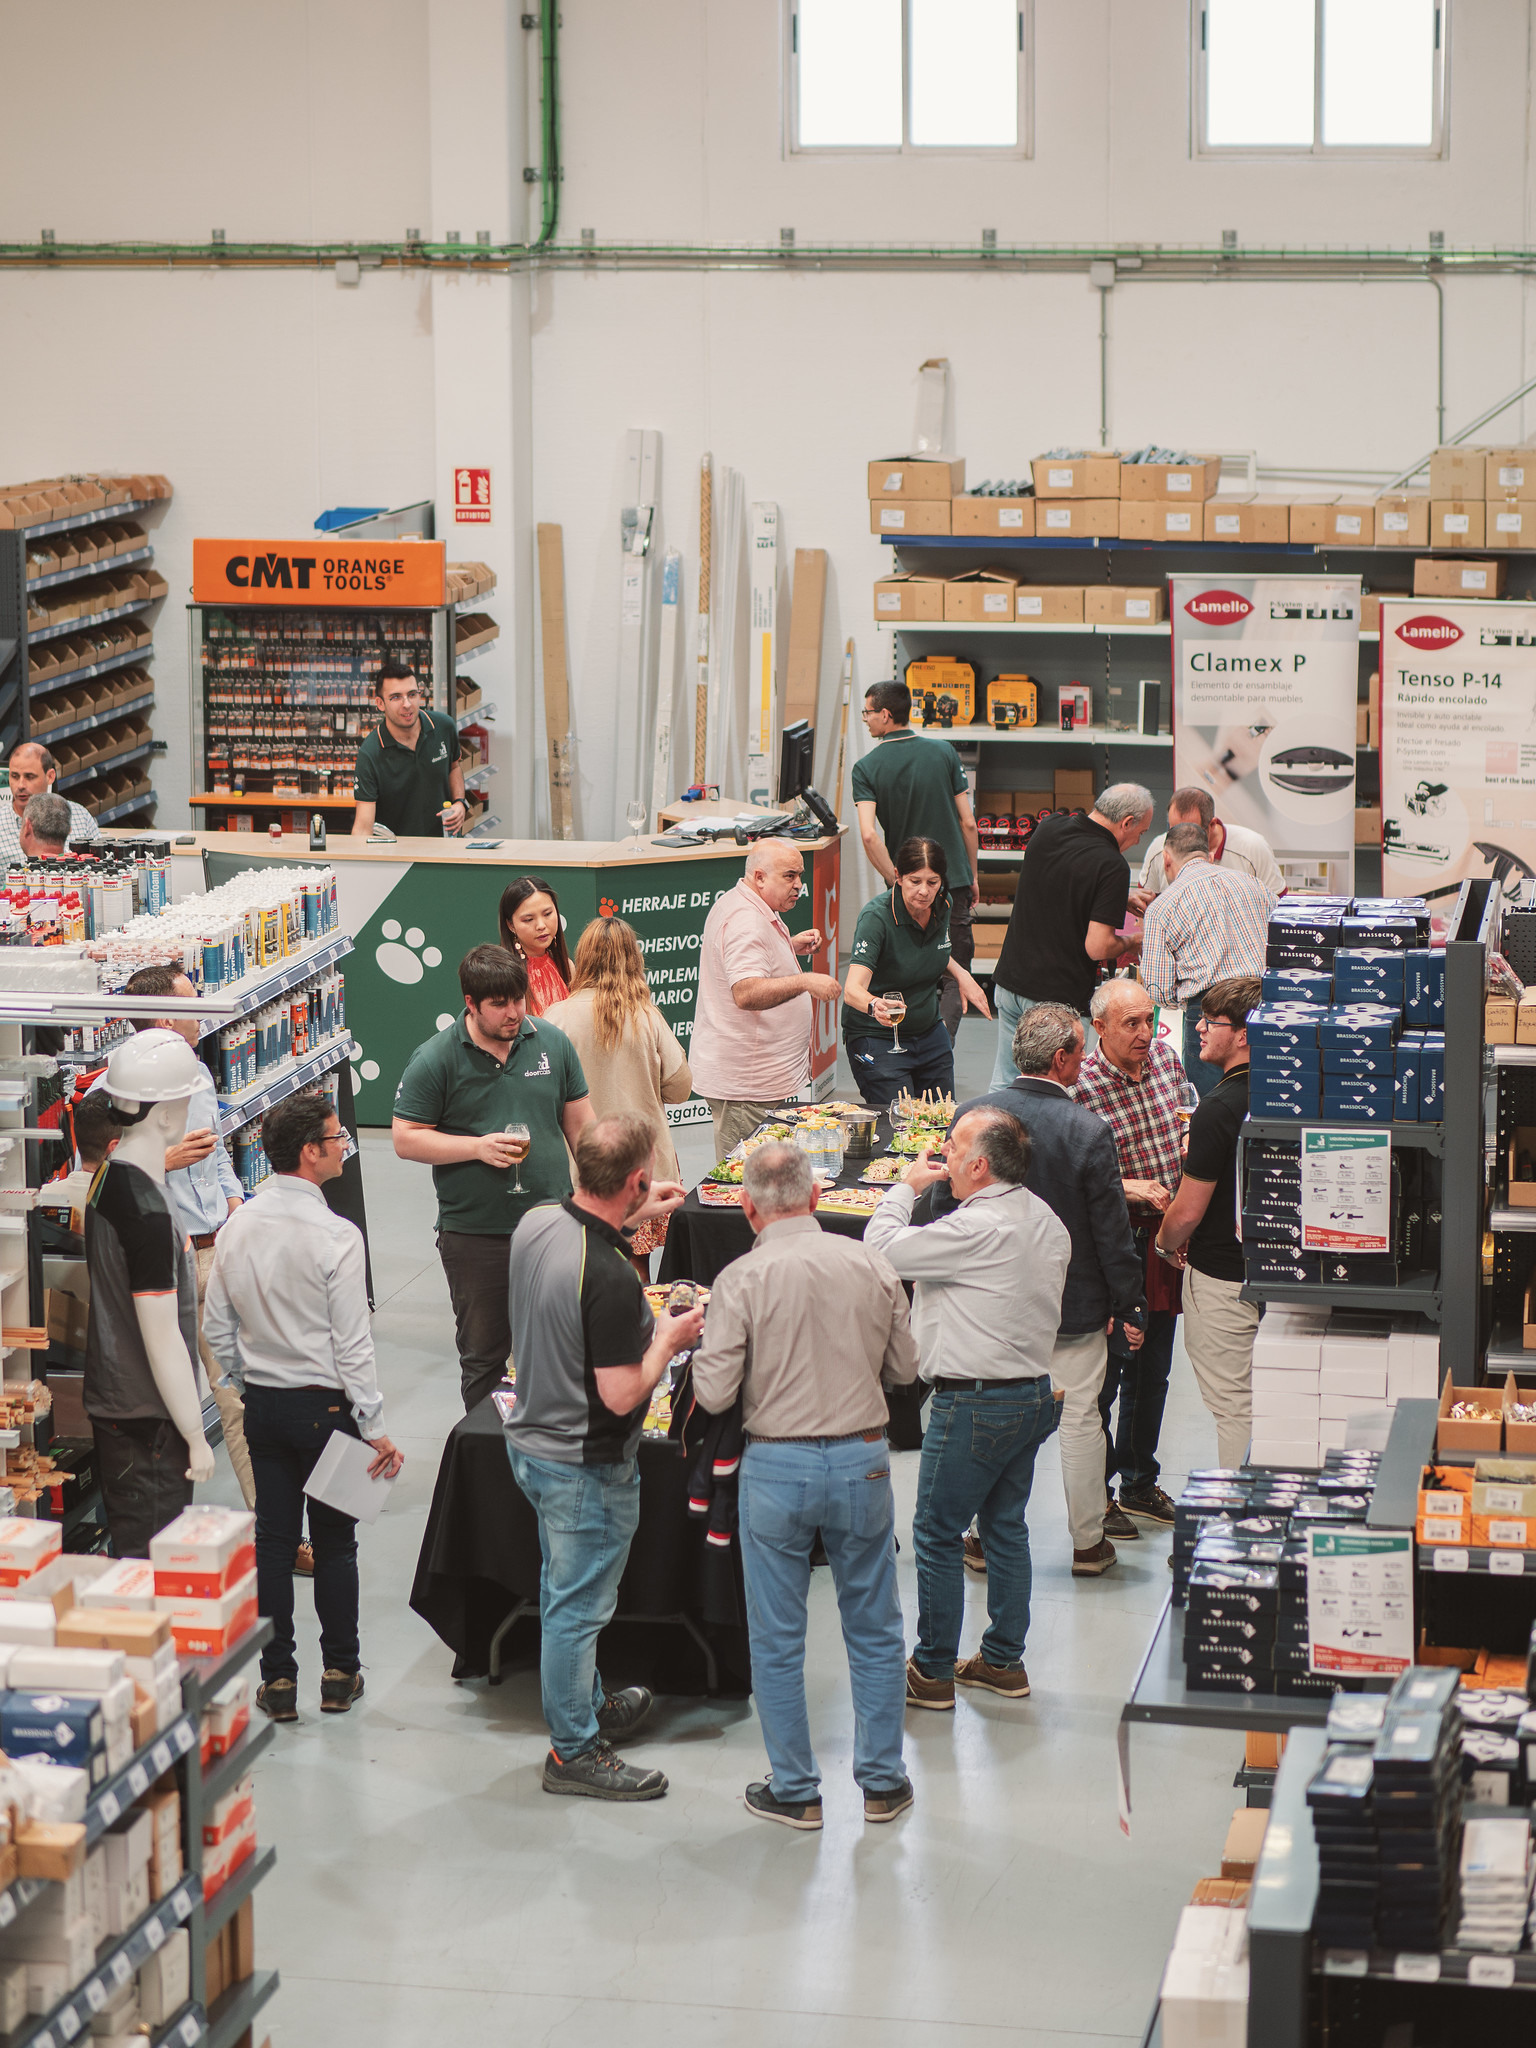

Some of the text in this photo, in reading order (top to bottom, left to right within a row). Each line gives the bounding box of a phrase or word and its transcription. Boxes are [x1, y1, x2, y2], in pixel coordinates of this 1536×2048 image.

[456, 512, 490, 520] EXTINTOR
[226, 553, 316, 589] CMT
[323, 559, 404, 574] ORANGE
[1192, 600, 1248, 613] Lamello
[1402, 625, 1459, 639] Lamello
[1190, 652, 1306, 672] Clamex P
[1398, 670, 1502, 688] Tenso P-14
[1191, 681, 1293, 691] Elemento de ensamblaje
[1190, 694, 1304, 704] desmontable para muebles
[1398, 692, 1488, 705] Rápido encolado
[1396, 712, 1425, 720] Invisible
[1438, 724, 1460, 732] ayuda
[1472, 724, 1504, 732] encolado
[1500, 776, 1508, 784] of
[1509, 776, 1520, 784] the
[151, 871, 160, 914] oudafoam
[622, 894, 686, 914] HERRAJE
[690, 892, 710, 908] DE
[637, 934, 706, 954] DHESIVOS
[666, 1106, 712, 1123] sgatos
[1258, 1242, 1294, 1250] BRASSOCHO
